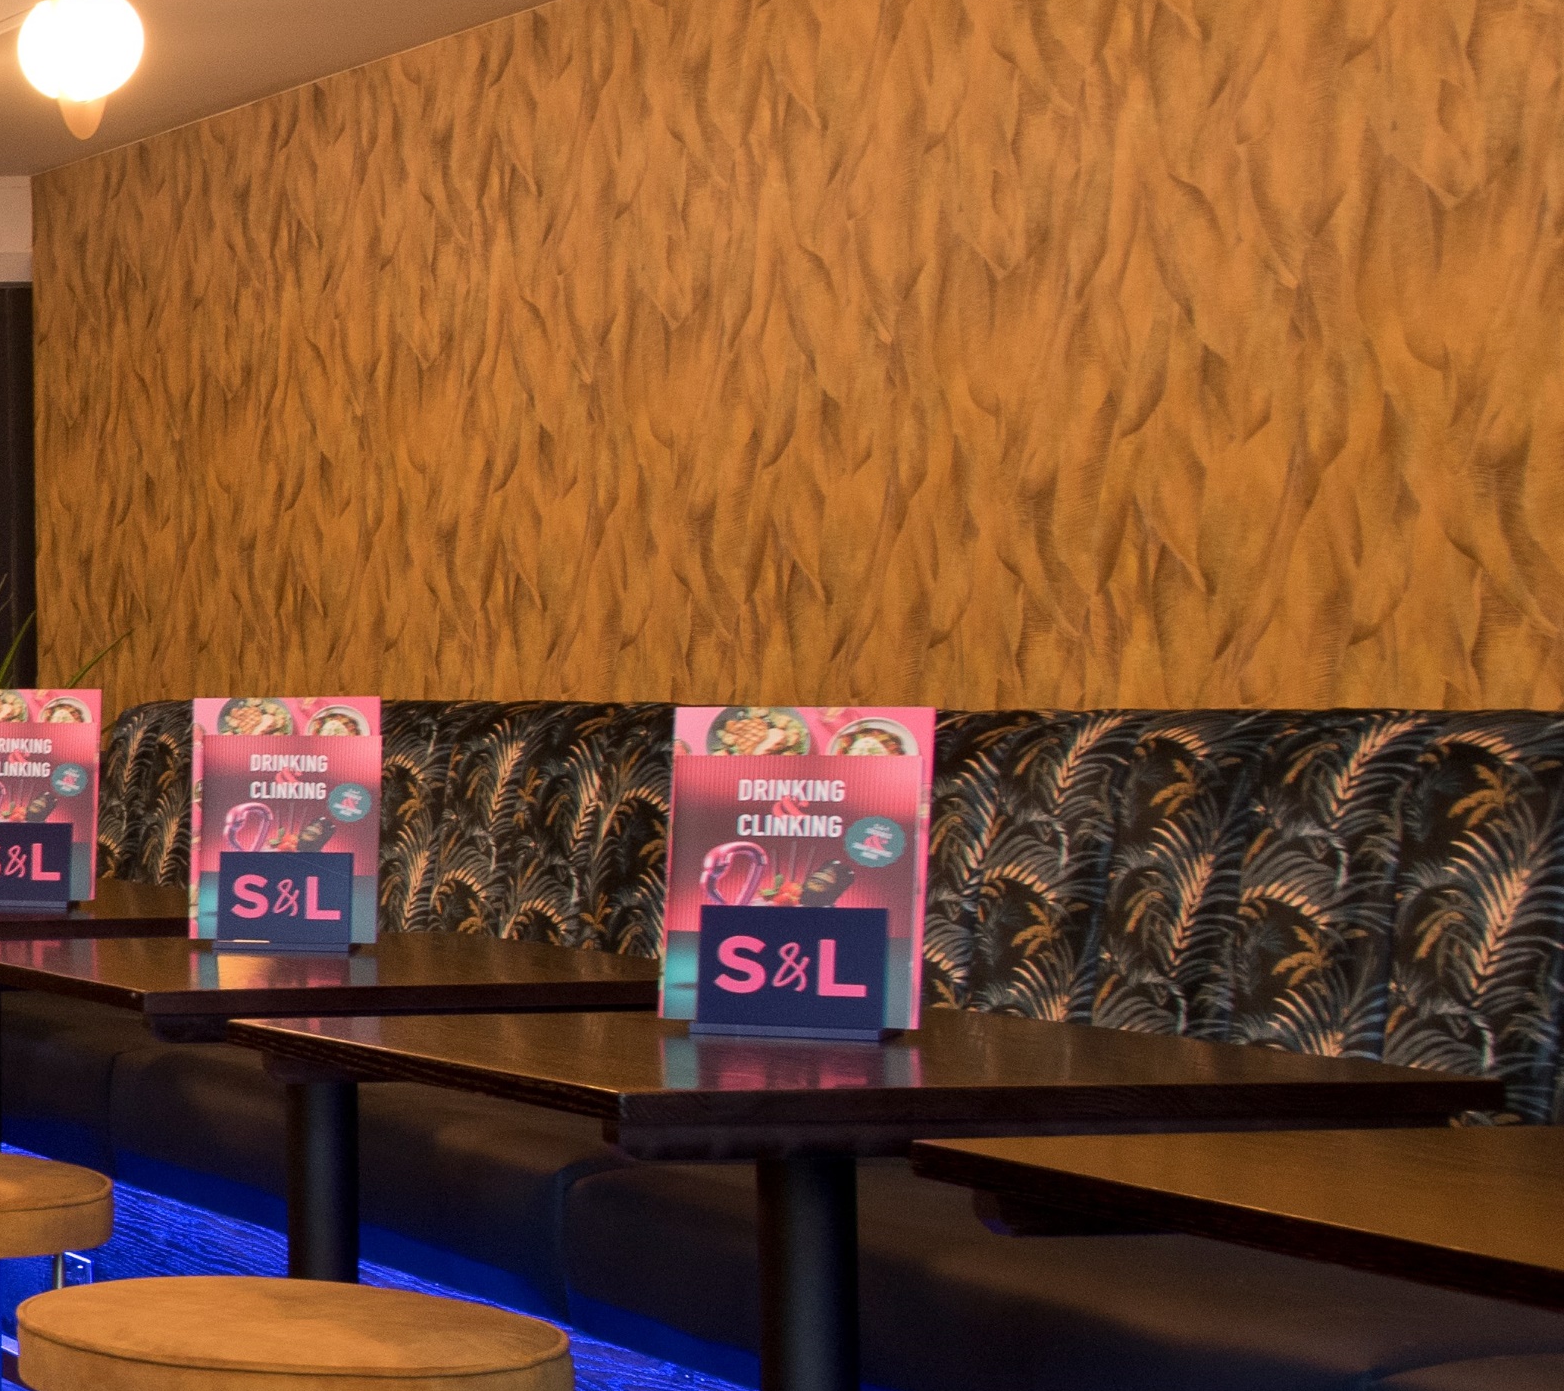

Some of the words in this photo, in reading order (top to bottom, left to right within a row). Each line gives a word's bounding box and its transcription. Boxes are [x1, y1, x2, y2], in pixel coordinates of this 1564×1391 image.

[249, 753, 328, 772] DRINKING
[249, 781, 327, 800] CLINKING
[737, 778, 846, 802] DRINKING
[736, 814, 843, 837] CLINKING
[231, 873, 341, 921] S&L
[714, 935, 867, 998] S&L
